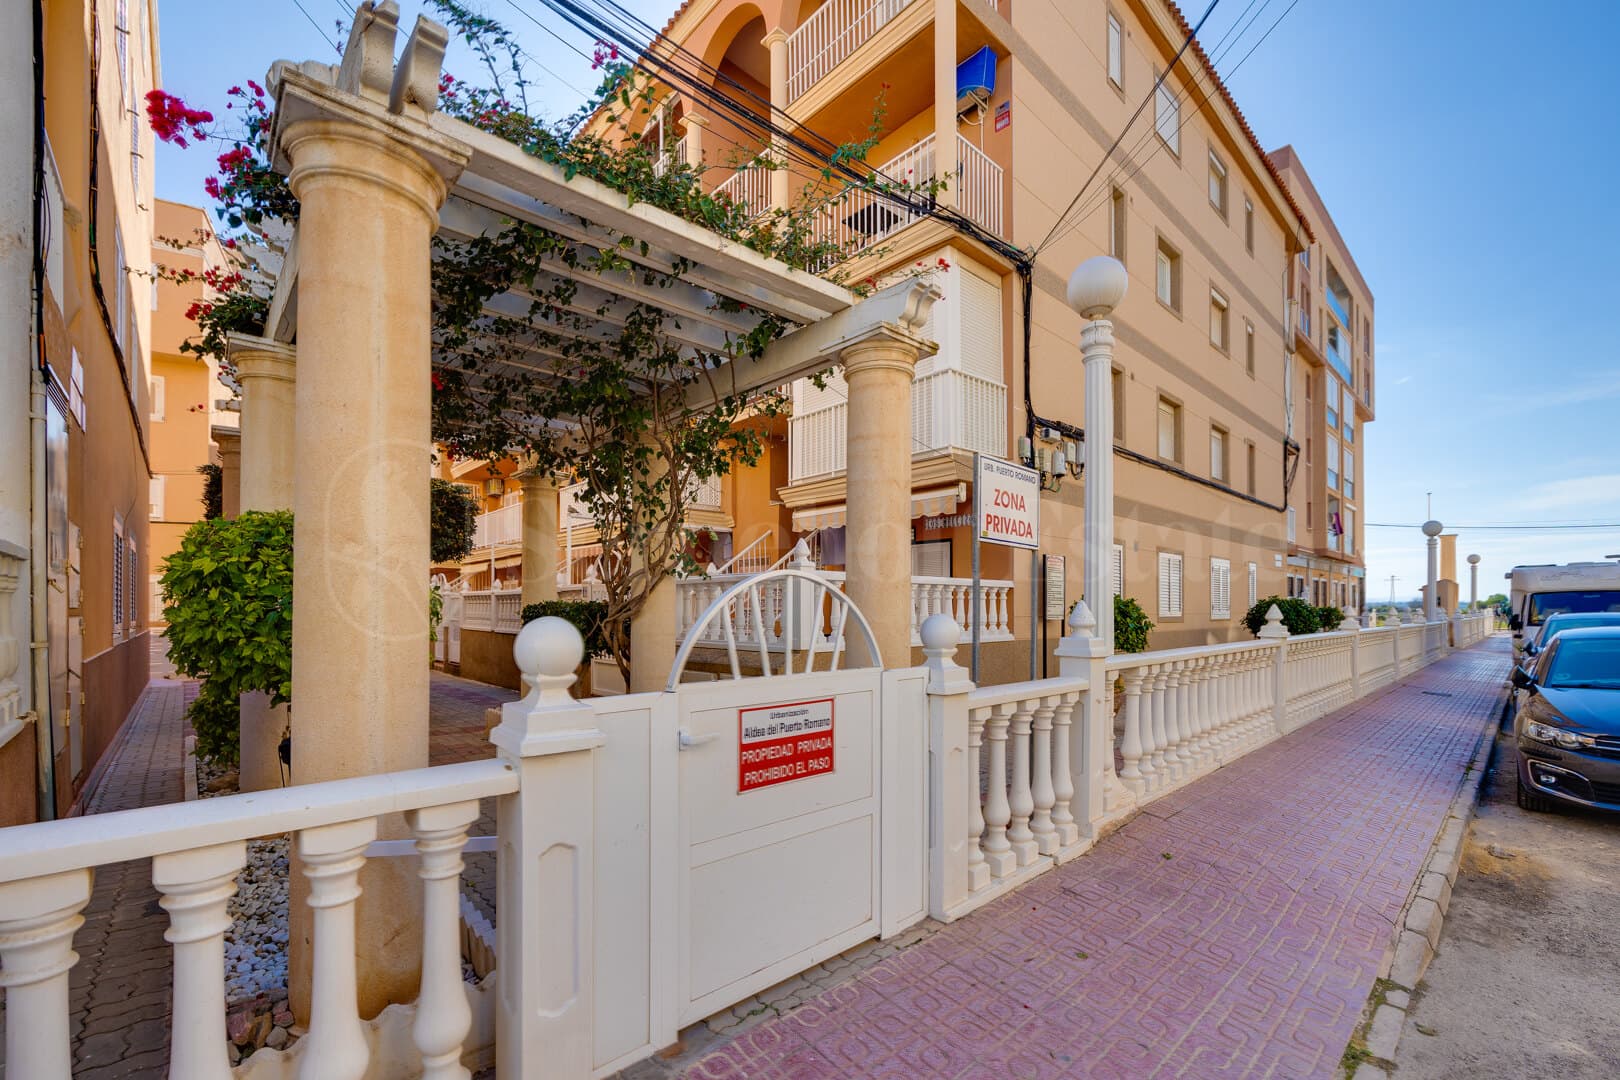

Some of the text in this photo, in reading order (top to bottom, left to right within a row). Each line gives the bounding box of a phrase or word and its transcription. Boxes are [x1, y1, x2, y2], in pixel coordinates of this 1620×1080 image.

[996, 465, 1015, 478] PUERTO
[1015, 471, 1036, 485] ROMANO
[994, 488, 1027, 513] ZONA
[986, 513, 1034, 540] PRIVADA
[744, 717, 831, 739] Aldea del Puerto Romano
[741, 736, 832, 764] PROPIEDAD PRIVADA
[743, 756, 831, 786] PROHIBIDO EL PASO
